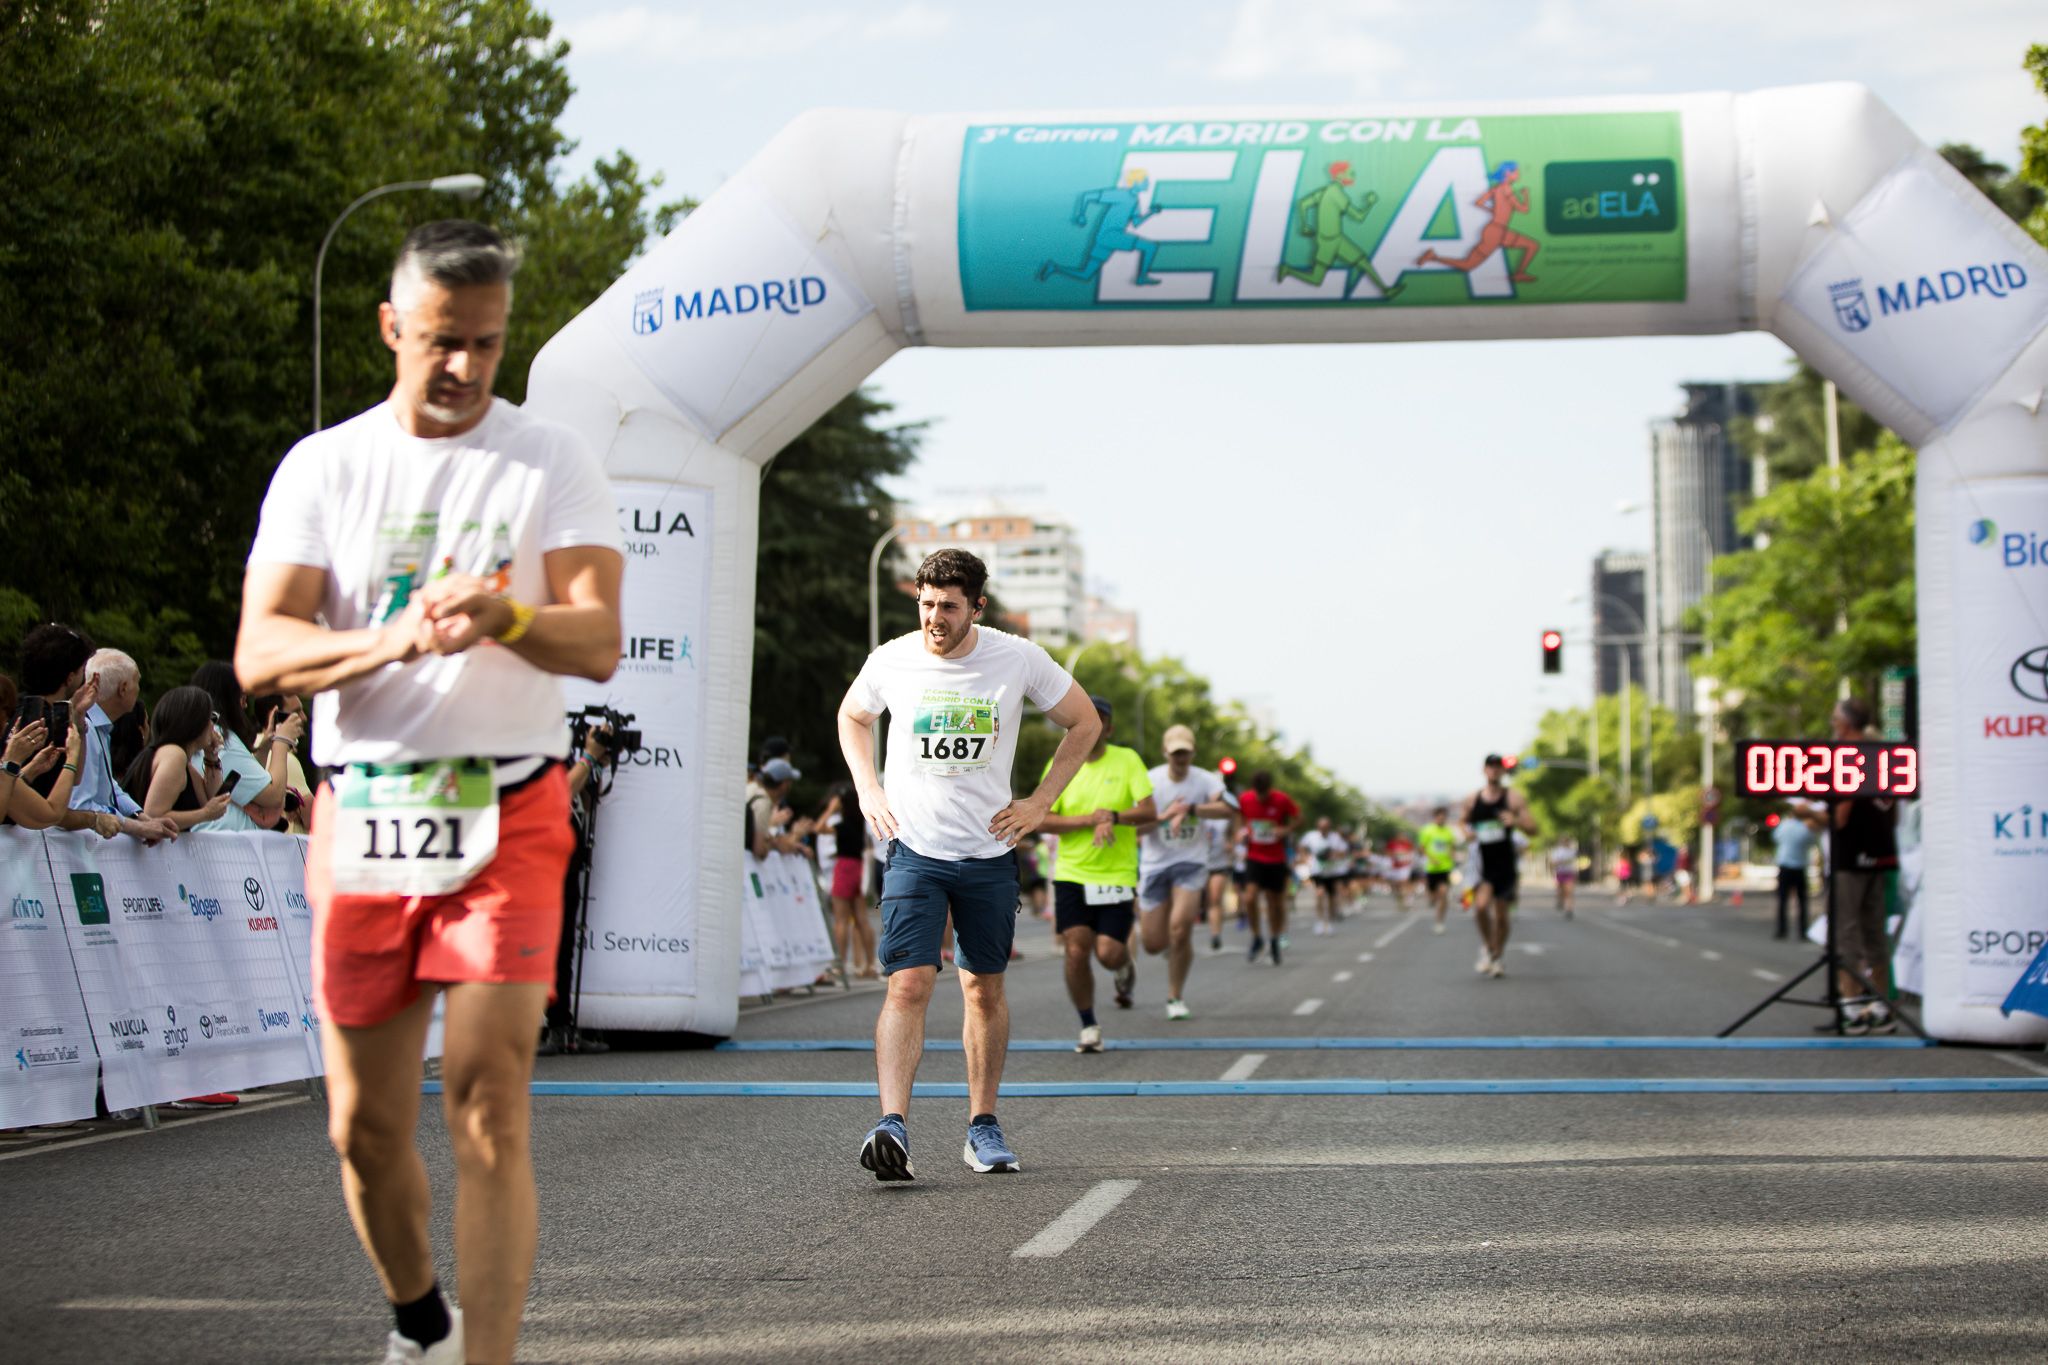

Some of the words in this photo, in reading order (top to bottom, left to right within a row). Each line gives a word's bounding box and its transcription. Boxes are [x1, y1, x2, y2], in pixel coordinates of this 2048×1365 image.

[1013, 127, 1119, 143] Carrera
[1129, 123, 1310, 145] MADRID
[1320, 121, 1417, 143] CON
[1425, 119, 1482, 141] LA
[1562, 191, 1660, 220] adELA
[1096, 145, 1517, 302] ELA
[675, 276, 827, 321] MADRID
[1876, 262, 2028, 316] MADRID
[963, 697, 984, 705] CON
[929, 711, 977, 732] ELA
[920, 737, 987, 760] 1687
[363, 816, 465, 860] 1121
[122, 897, 163, 914] SPORTLIFE
[188, 894, 223, 922] Biogen
[604, 932, 690, 954] Services
[266, 1011, 290, 1029] MADRID
[163, 1026, 189, 1050] amigo
